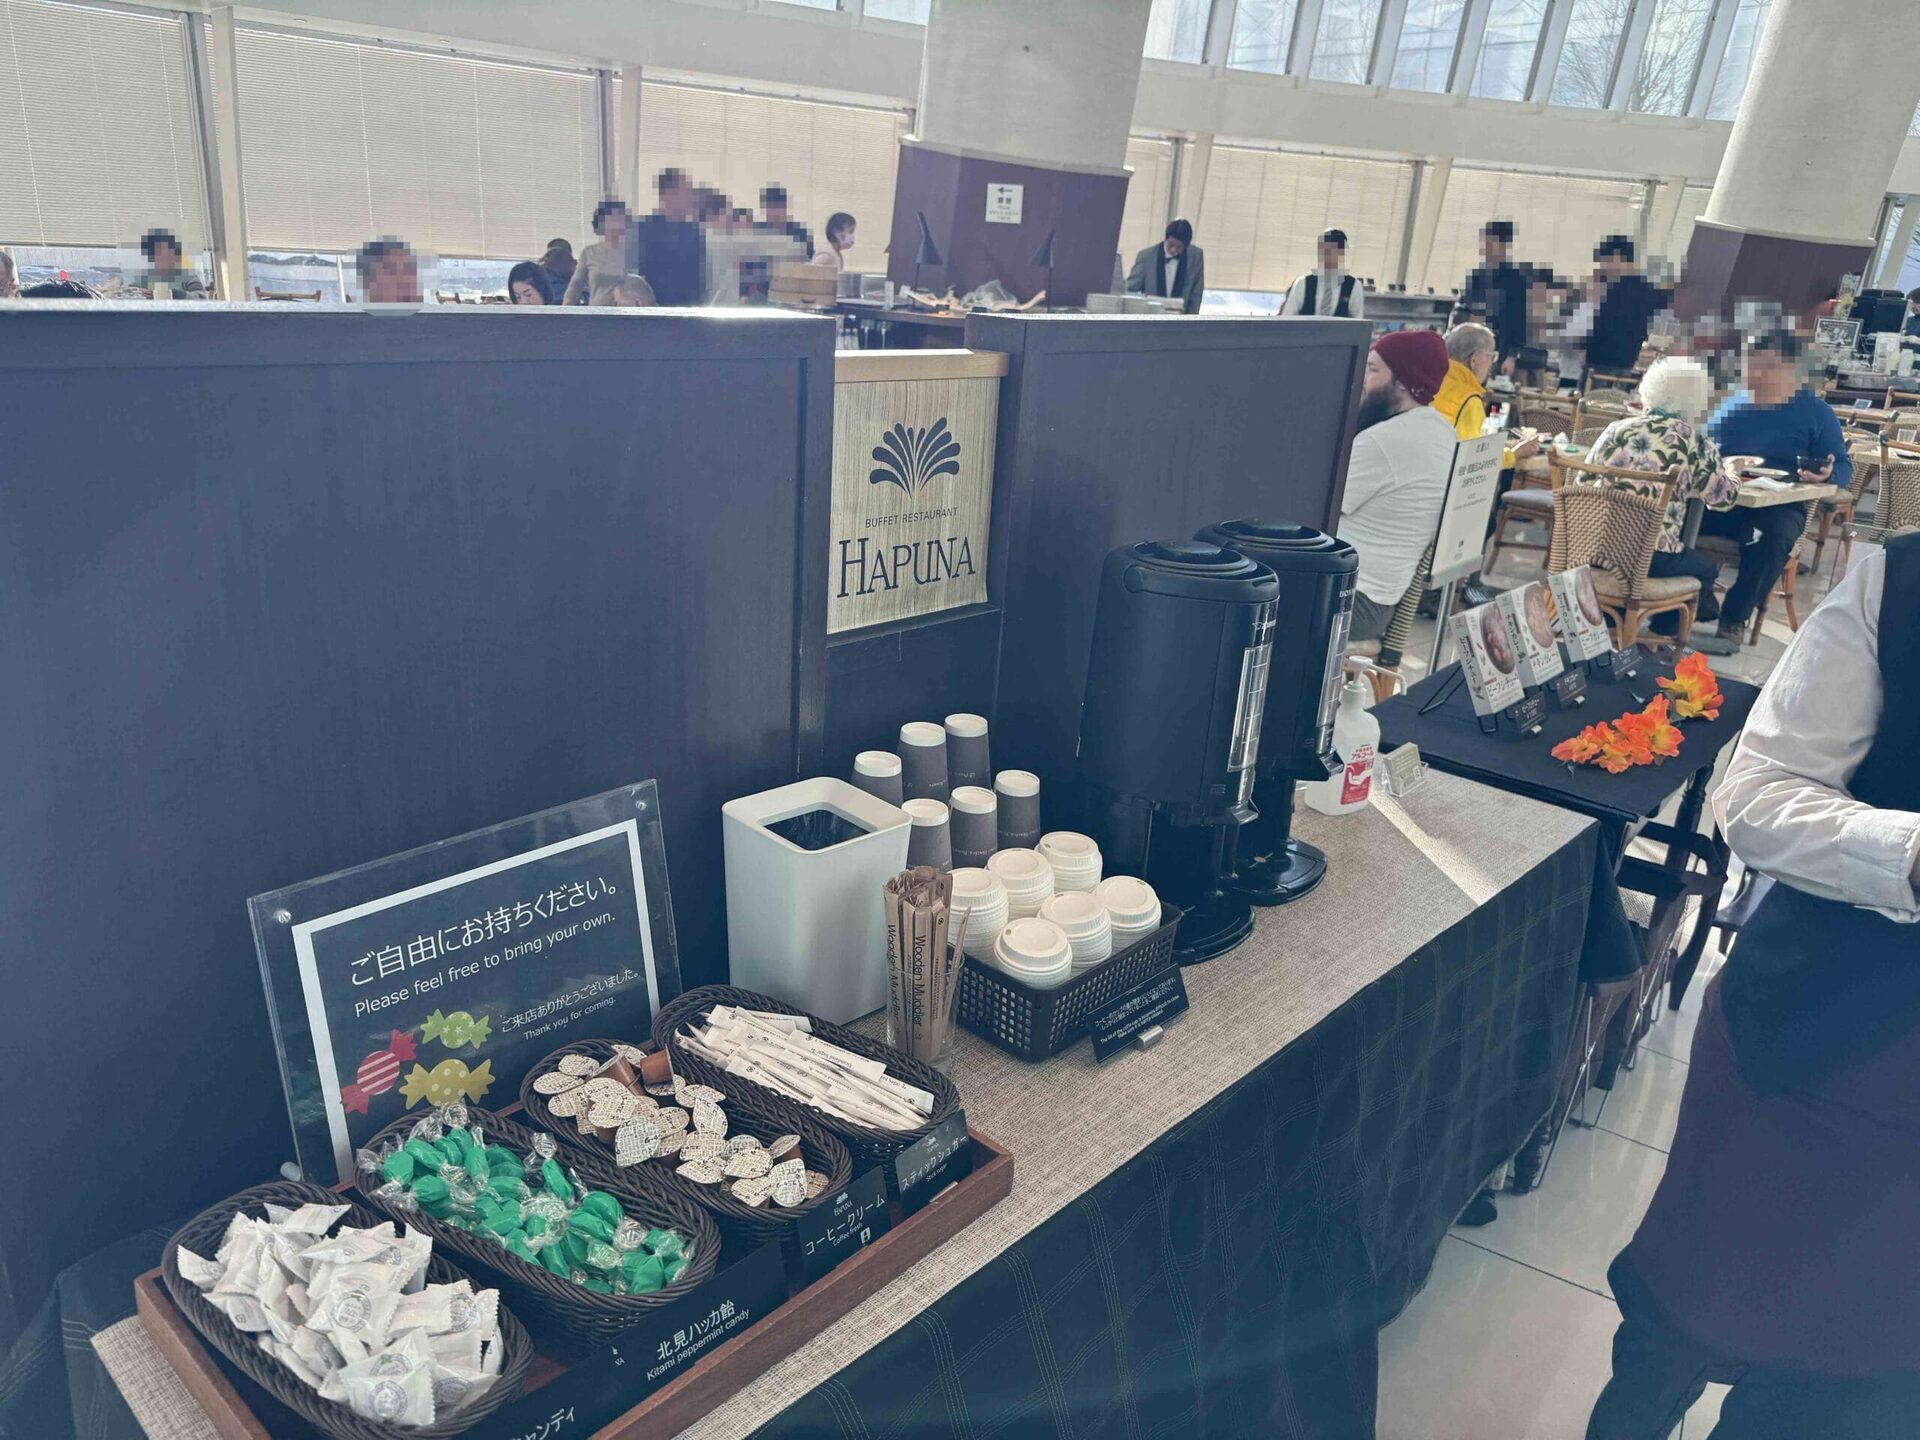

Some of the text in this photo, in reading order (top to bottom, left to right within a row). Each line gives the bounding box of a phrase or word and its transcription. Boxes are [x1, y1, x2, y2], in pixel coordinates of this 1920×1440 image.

[865, 506, 958, 528] BUFFET RESTAURANT
[837, 537, 976, 598] HAPUNA
[351, 876, 616, 986] ご自由にお持ちください。
[887, 924, 896, 971] Wooden
[355, 912, 616, 1017] Please feel free to bring your own.
[914, 935, 926, 1026] Wooden Muddler
[502, 968, 639, 1033] ご来店ありがとうございました。
[523, 995, 617, 1041] Thank you for coming.
[902, 1136, 967, 1192] スティックシュガー
[806, 1194, 885, 1256] コーヒークリーム
[833, 1222, 862, 1247] Coffee fresh
[647, 1309, 750, 1381] Kitami peppermint candy
[656, 1300, 736, 1361] 北見ハッカ飴
